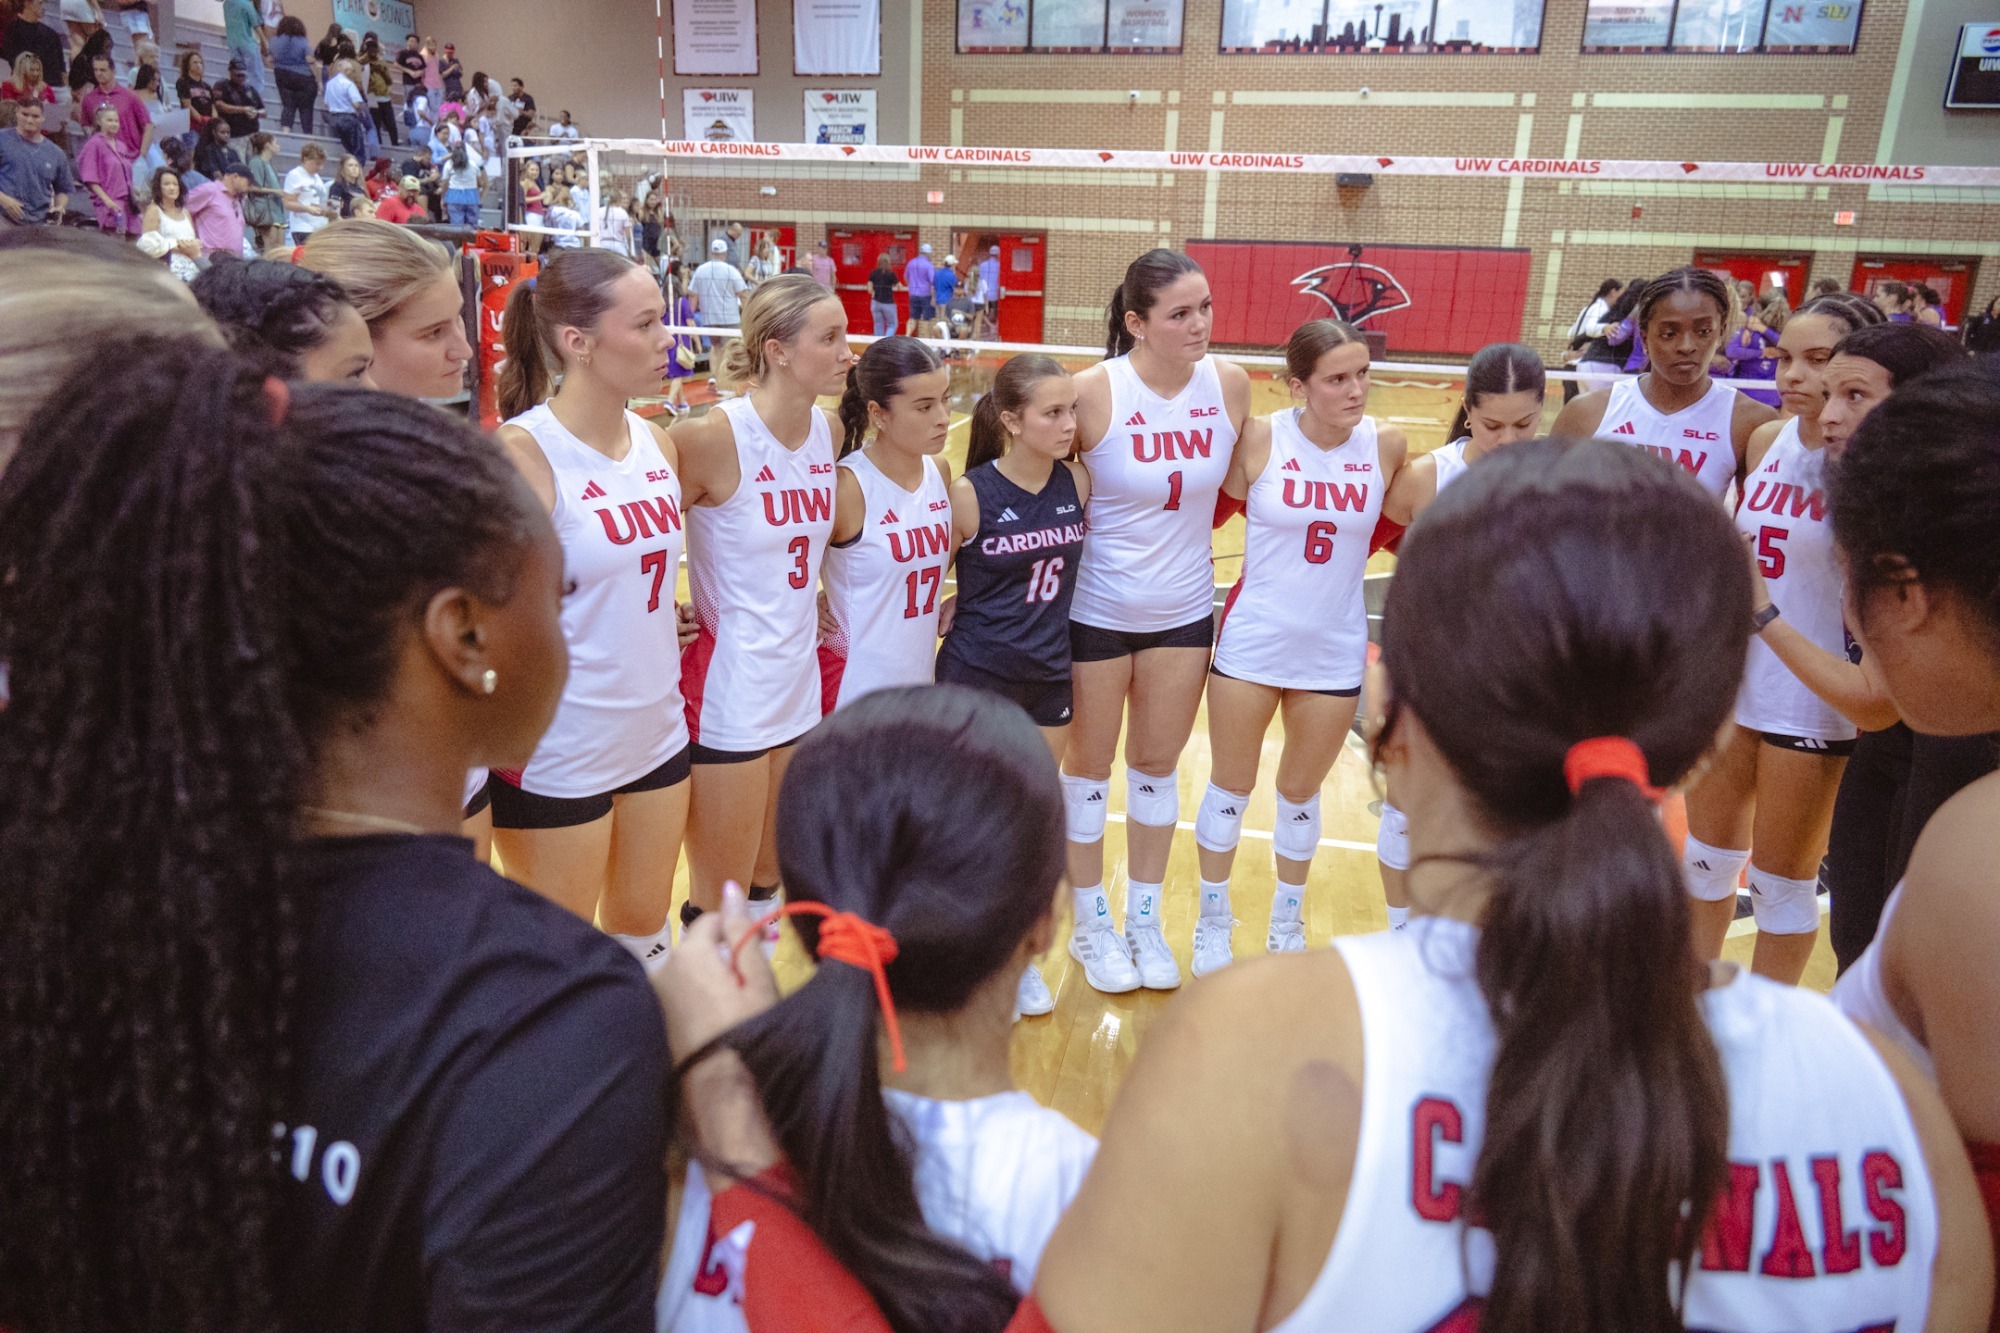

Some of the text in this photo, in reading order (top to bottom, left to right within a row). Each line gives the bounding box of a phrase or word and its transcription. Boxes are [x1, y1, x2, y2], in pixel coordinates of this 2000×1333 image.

[714, 92, 739, 103] UIW
[836, 93, 862, 103] UIW
[666, 142, 780, 156] UIW CARDINALS
[908, 147, 1032, 162] UIW CARDINALS
[1170, 153, 1304, 168] UIW CARDINALS
[1455, 158, 1600, 174] UIW CARDINALS
[1765, 163, 1925, 180] UIW CARDINALS
[483, 263, 514, 277] UIW
[1131, 427, 1213, 463] UIW
[760, 487, 831, 526] UIW
[1163, 470, 1183, 511] 1
[1282, 478, 1369, 512] UIW
[1747, 481, 1829, 522] UIW
[593, 494, 682, 545] UIW
[886, 521, 949, 563] UIW
[1304, 520, 1338, 565] 6
[788, 535, 810, 590] 3
[1025, 556, 1065, 605] 16
[641, 549, 668, 614] 7
[904, 565, 942, 619] 17
